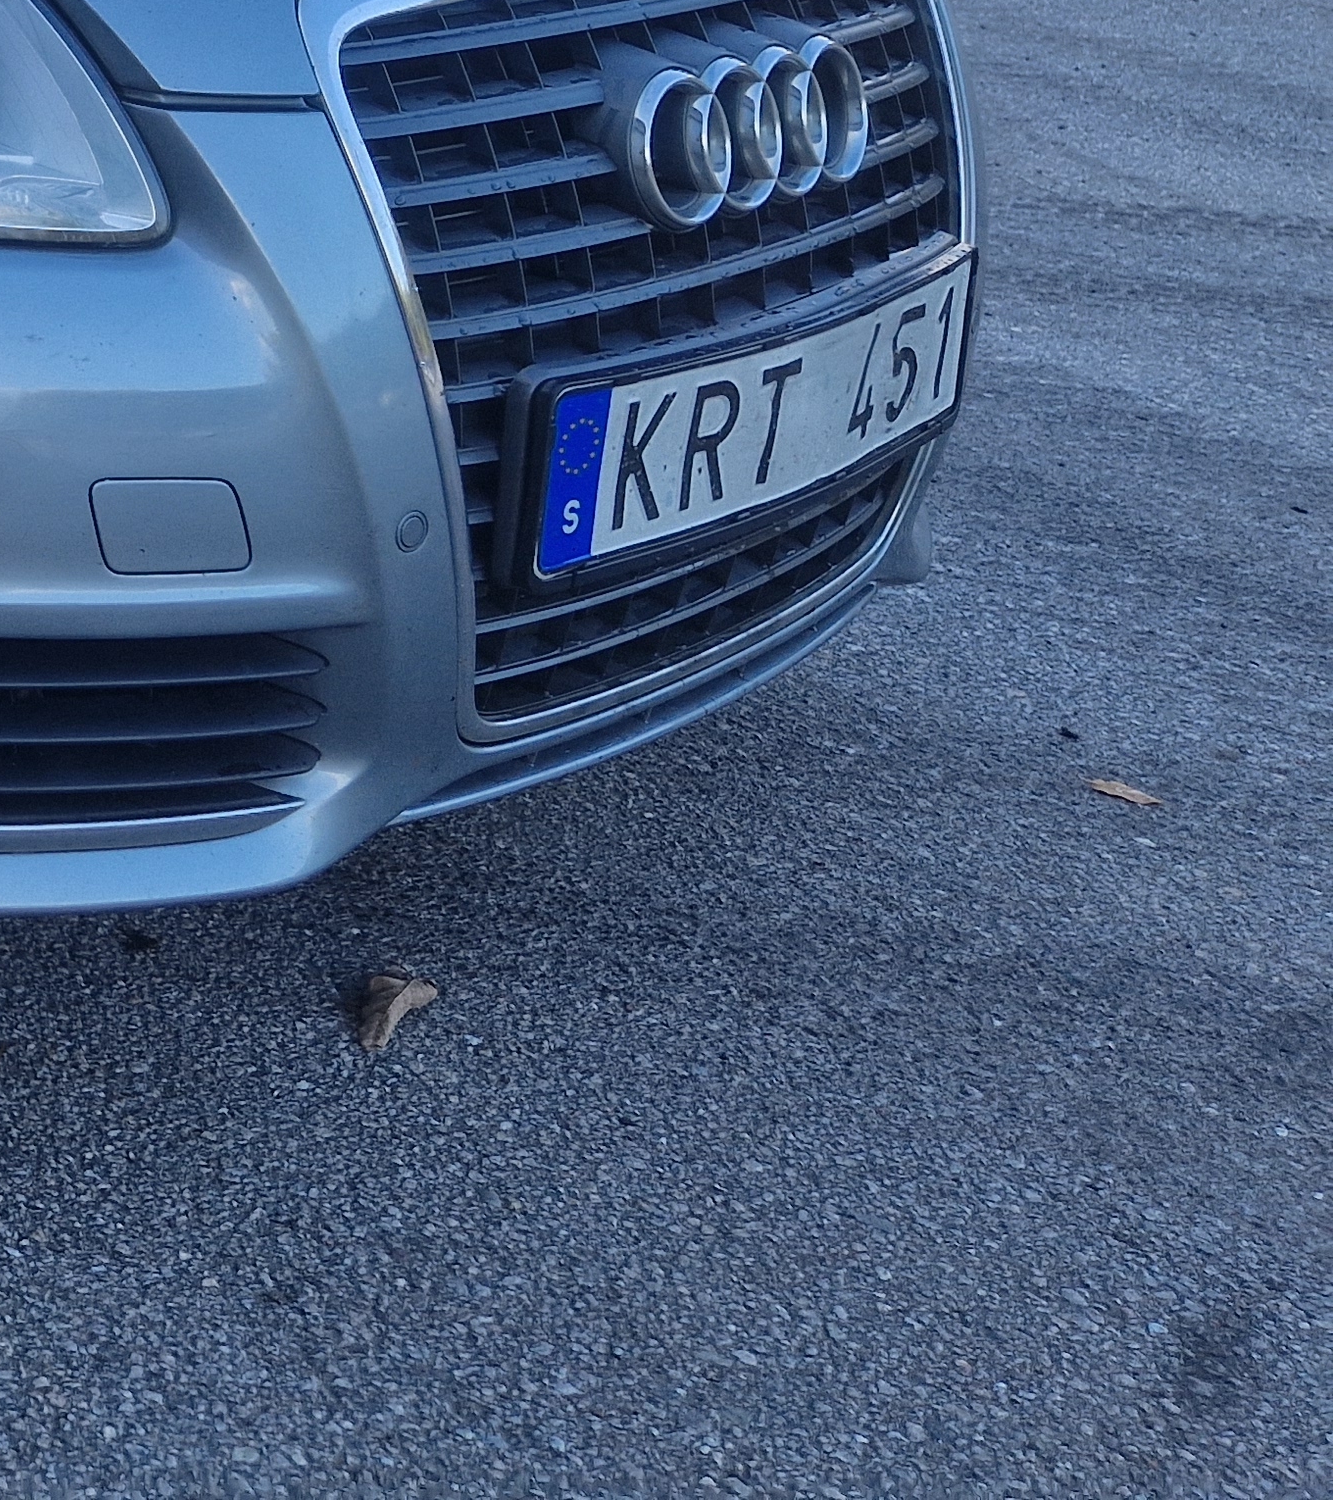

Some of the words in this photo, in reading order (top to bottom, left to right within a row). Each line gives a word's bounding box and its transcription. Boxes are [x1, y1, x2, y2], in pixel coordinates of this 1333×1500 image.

[612, 358, 803, 531] KRT
[847, 286, 955, 439] 451
[562, 499, 581, 534] S
